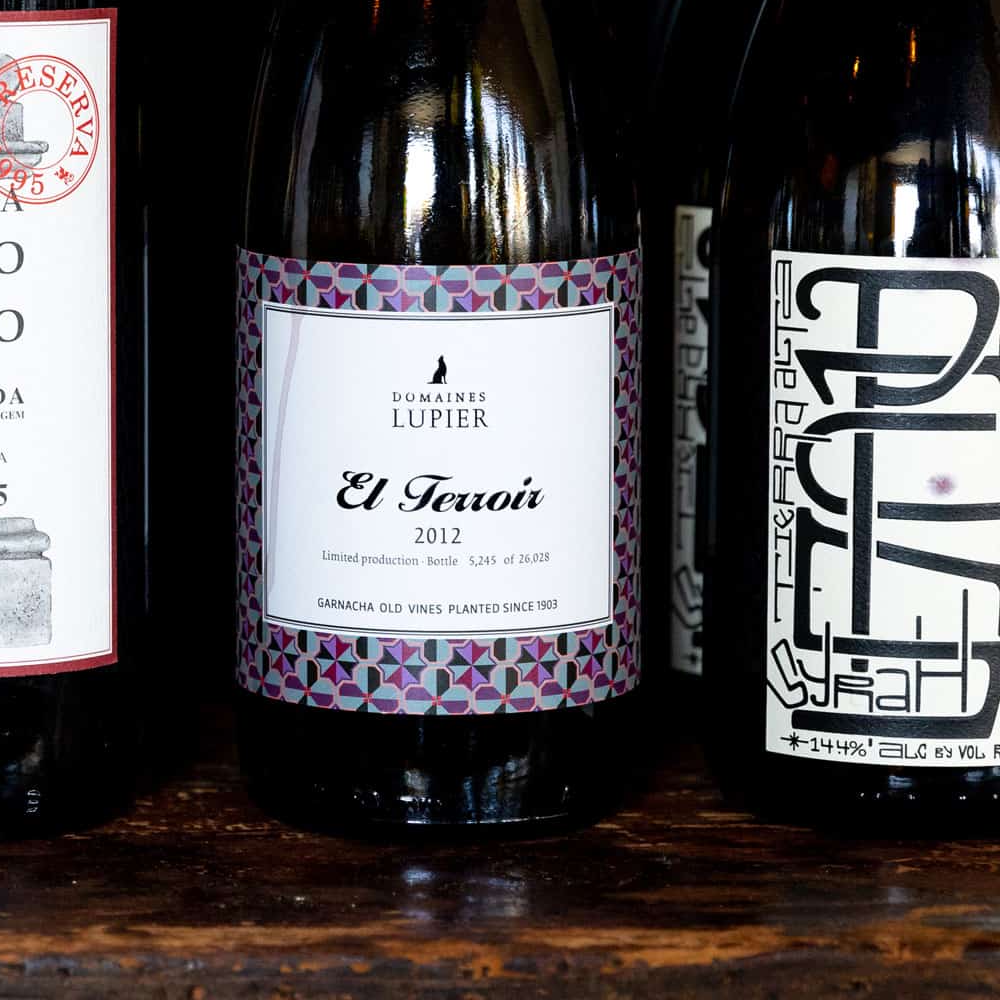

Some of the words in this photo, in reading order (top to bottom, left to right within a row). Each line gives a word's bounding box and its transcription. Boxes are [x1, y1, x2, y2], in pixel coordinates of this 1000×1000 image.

[391, 391, 487, 403] DOMAINES
[391, 407, 489, 429] LUPIER
[336, 470, 390, 512] El
[397, 474, 546, 513] Terroir
[414, 526, 463, 545] 2012
[321, 550, 359, 564] Limited
[360, 553, 420, 567] production
[426, 554, 459, 567] Bottle
[468, 554, 498, 568] 5,245
[503, 553, 516, 566] of
[518, 551, 551, 565] 26,028
[316, 597, 376, 613] GARNACHA
[379, 602, 404, 614] OLD
[407, 603, 443, 615] VINES
[448, 601, 500, 615] PLANTED
[503, 601, 534, 613] SINCE
[536, 598, 559, 611] 1903
[958, 744, 986, 760] VOL
